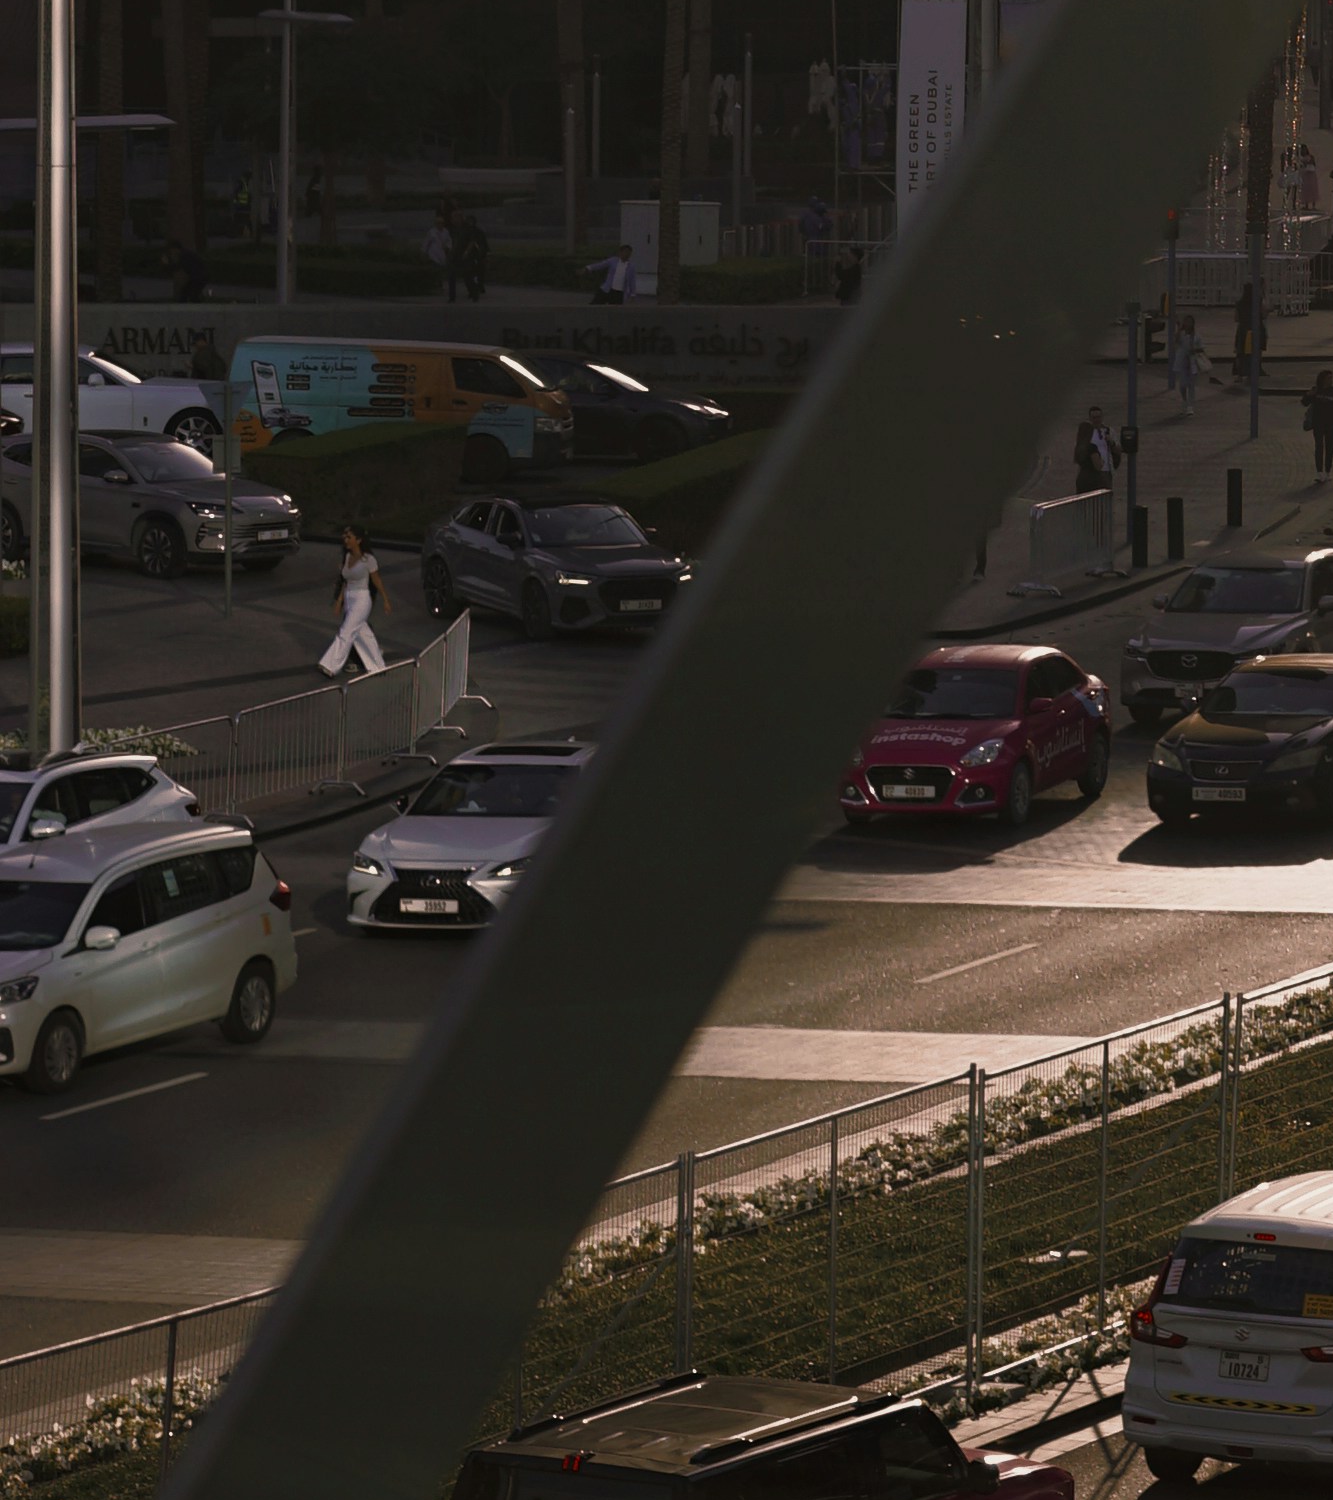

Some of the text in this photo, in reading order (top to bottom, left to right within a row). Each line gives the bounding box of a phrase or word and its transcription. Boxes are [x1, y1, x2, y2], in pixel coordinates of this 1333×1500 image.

[928, 70, 939, 124] DUBAI
[944, 85, 953, 127] ESTATE
[909, 95, 920, 192] THE GREEN
[927, 132, 937, 154] OF
[573, 326, 675, 355] Khalifa
[689, 324, 765, 364] خليفة
[871, 732, 967, 746] instashop
[1228, 1362, 1260, 1378] 10724
